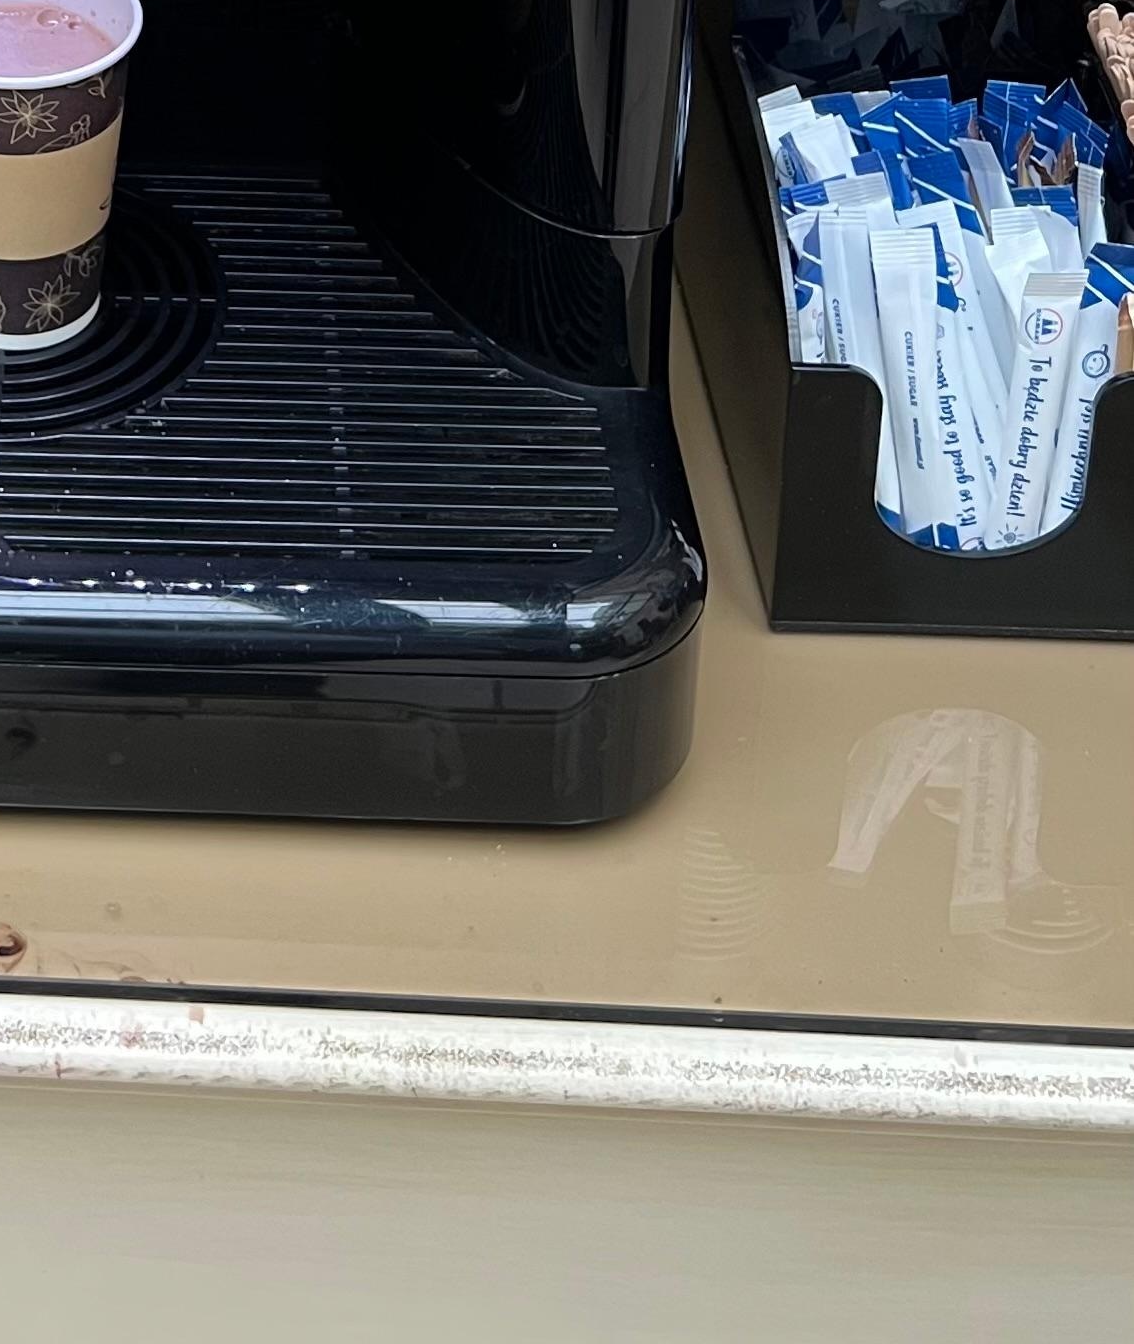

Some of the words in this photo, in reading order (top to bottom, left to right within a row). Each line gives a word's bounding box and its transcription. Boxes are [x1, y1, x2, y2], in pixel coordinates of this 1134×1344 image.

[1029, 356, 1052, 373] To
[939, 395, 957, 426] stay
[1022, 377, 1049, 422] będzie
[944, 431, 960, 446] to
[1009, 426, 1039, 469] dobry
[943, 449, 975, 485] good
[958, 489, 973, 503] so
[1006, 472, 1031, 517] dzień!
[955, 506, 978, 527] It's
